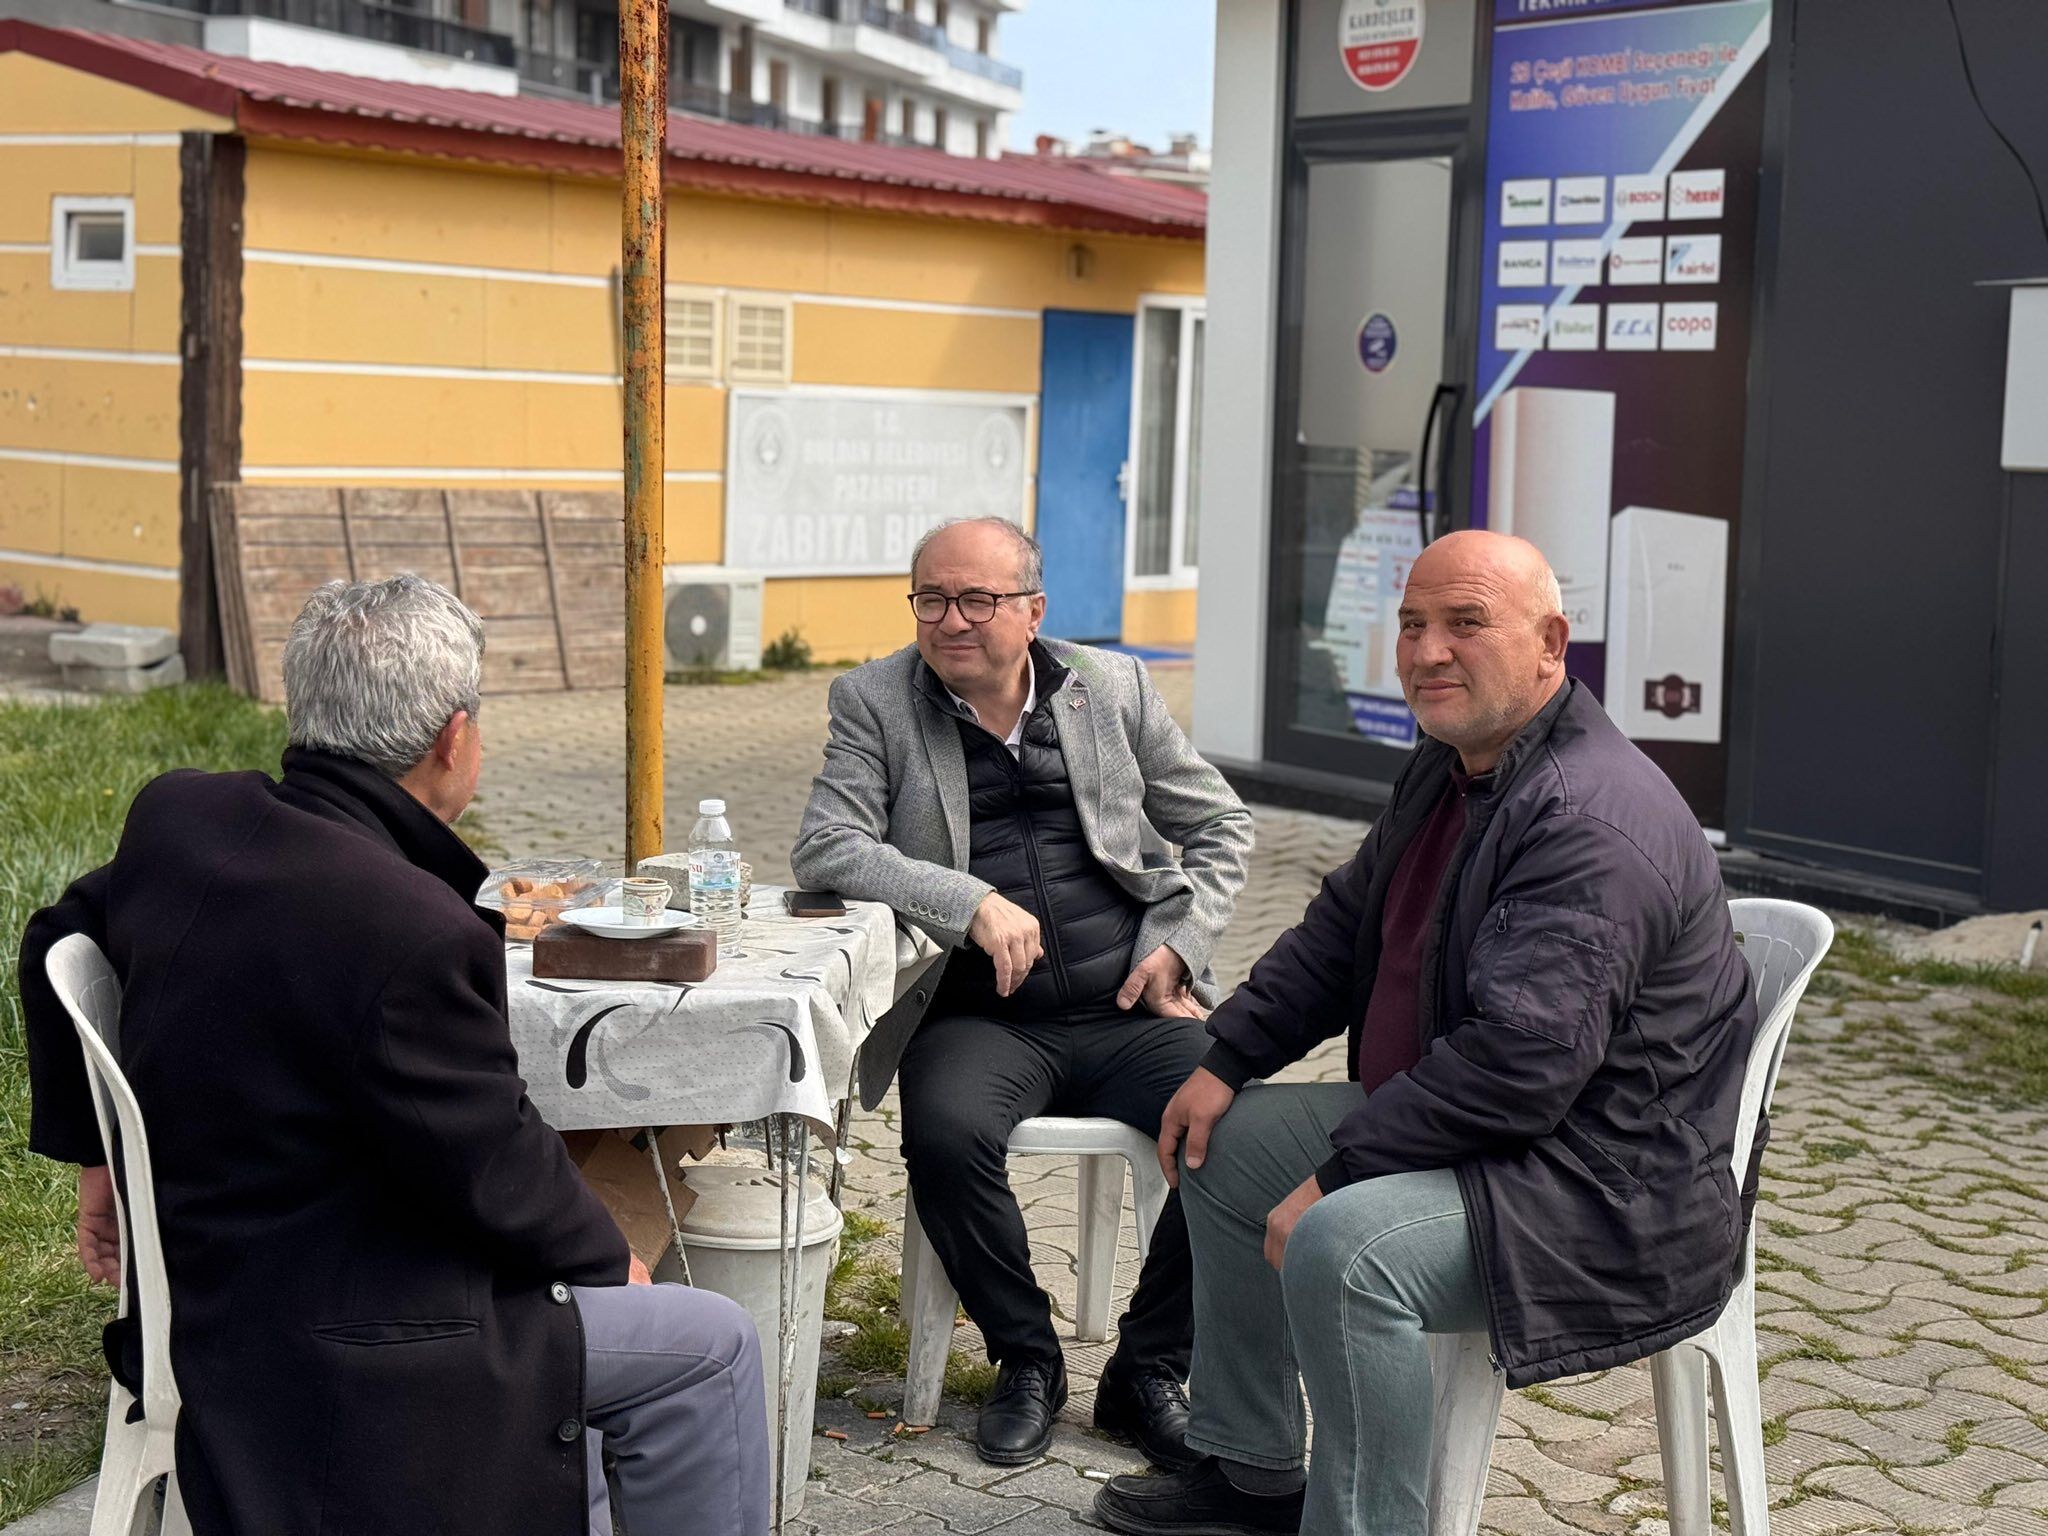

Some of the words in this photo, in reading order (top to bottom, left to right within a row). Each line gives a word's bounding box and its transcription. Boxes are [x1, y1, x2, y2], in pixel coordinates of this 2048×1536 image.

[1628, 191, 1663, 204] BOSCH
[1667, 317, 1713, 336] copa
[749, 513, 869, 564] ZABITA
